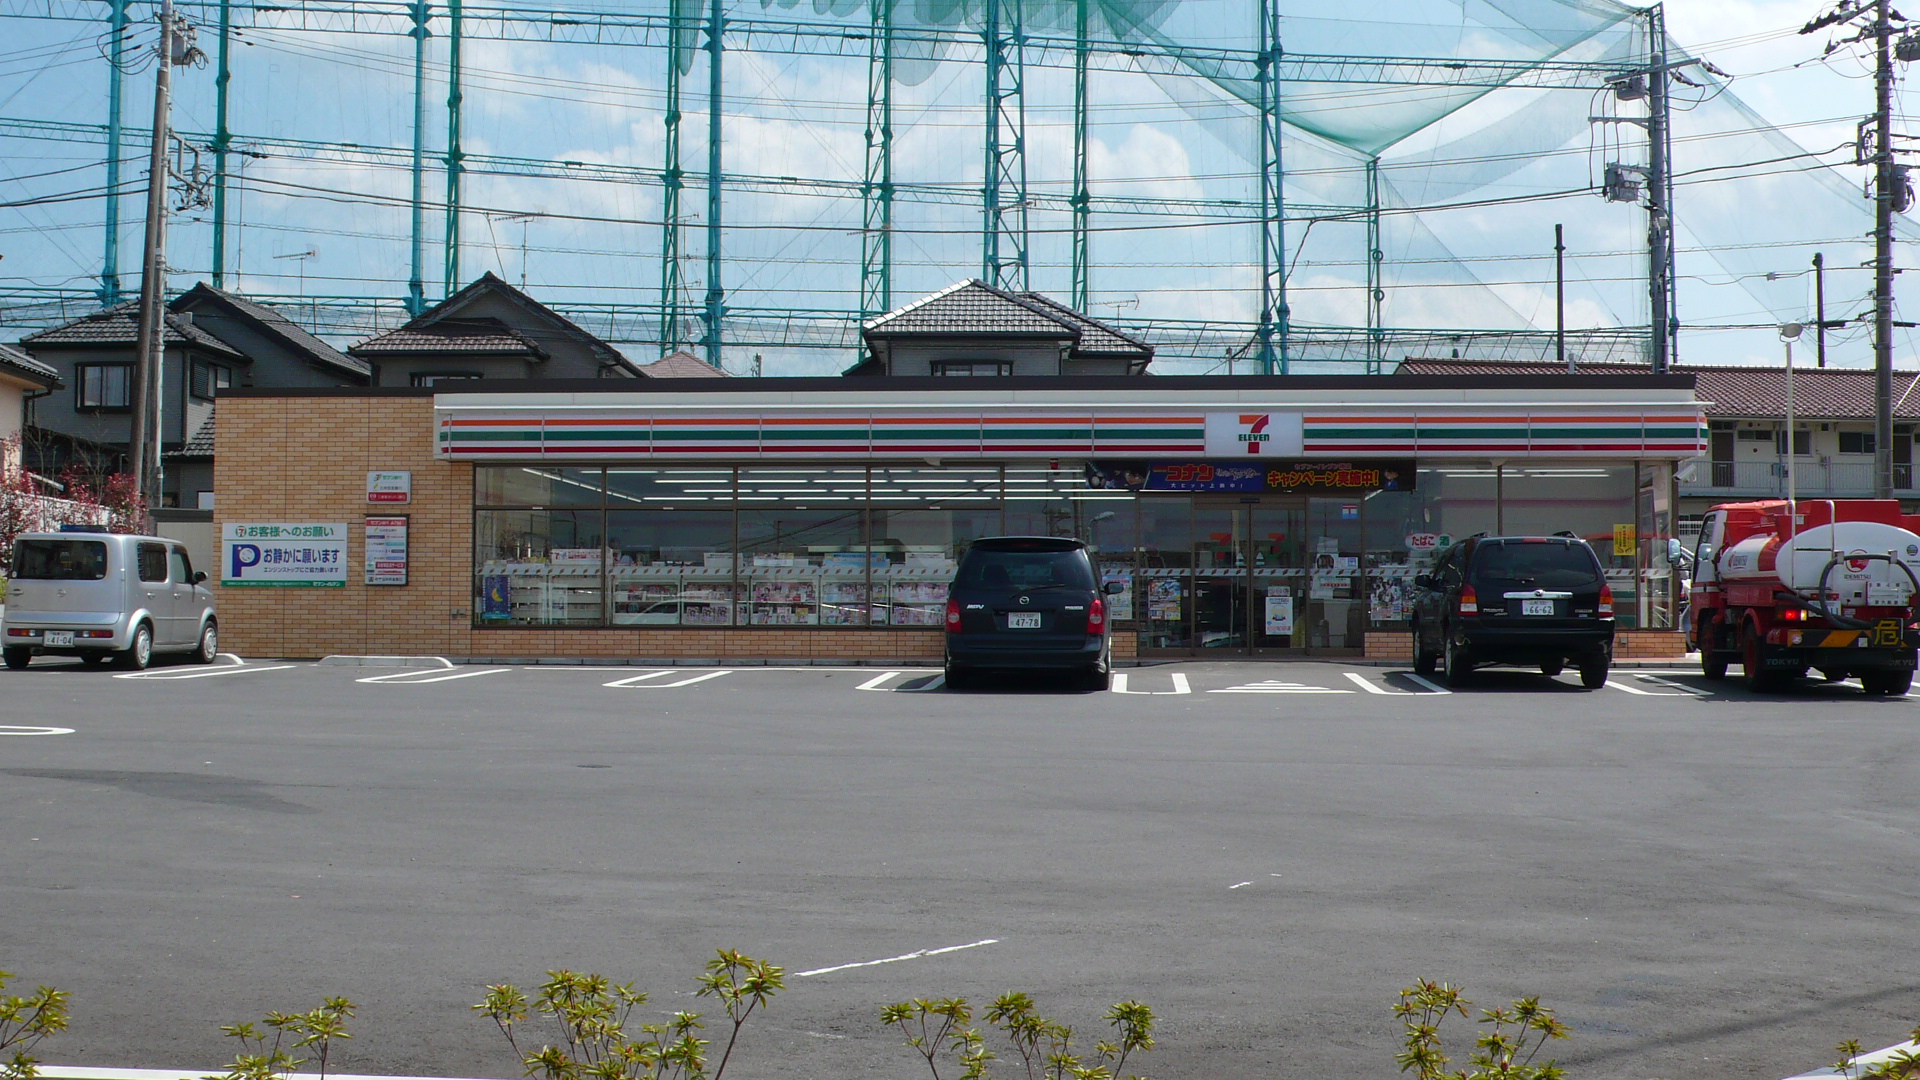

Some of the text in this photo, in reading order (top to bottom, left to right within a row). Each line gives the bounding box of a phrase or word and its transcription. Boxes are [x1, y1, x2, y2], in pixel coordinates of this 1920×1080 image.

[248, 526, 334, 537] お客様へのお願い
[1411, 535, 1435, 546] たばこ
[263, 548, 340, 564] お静かに願います
[1529, 606, 1552, 614] 66-62
[1015, 618, 1039, 627] 47-78
[1873, 620, 1900, 646] 危
[51, 636, 72, 645] 41-04
[1765, 658, 1800, 666] TOKYU
